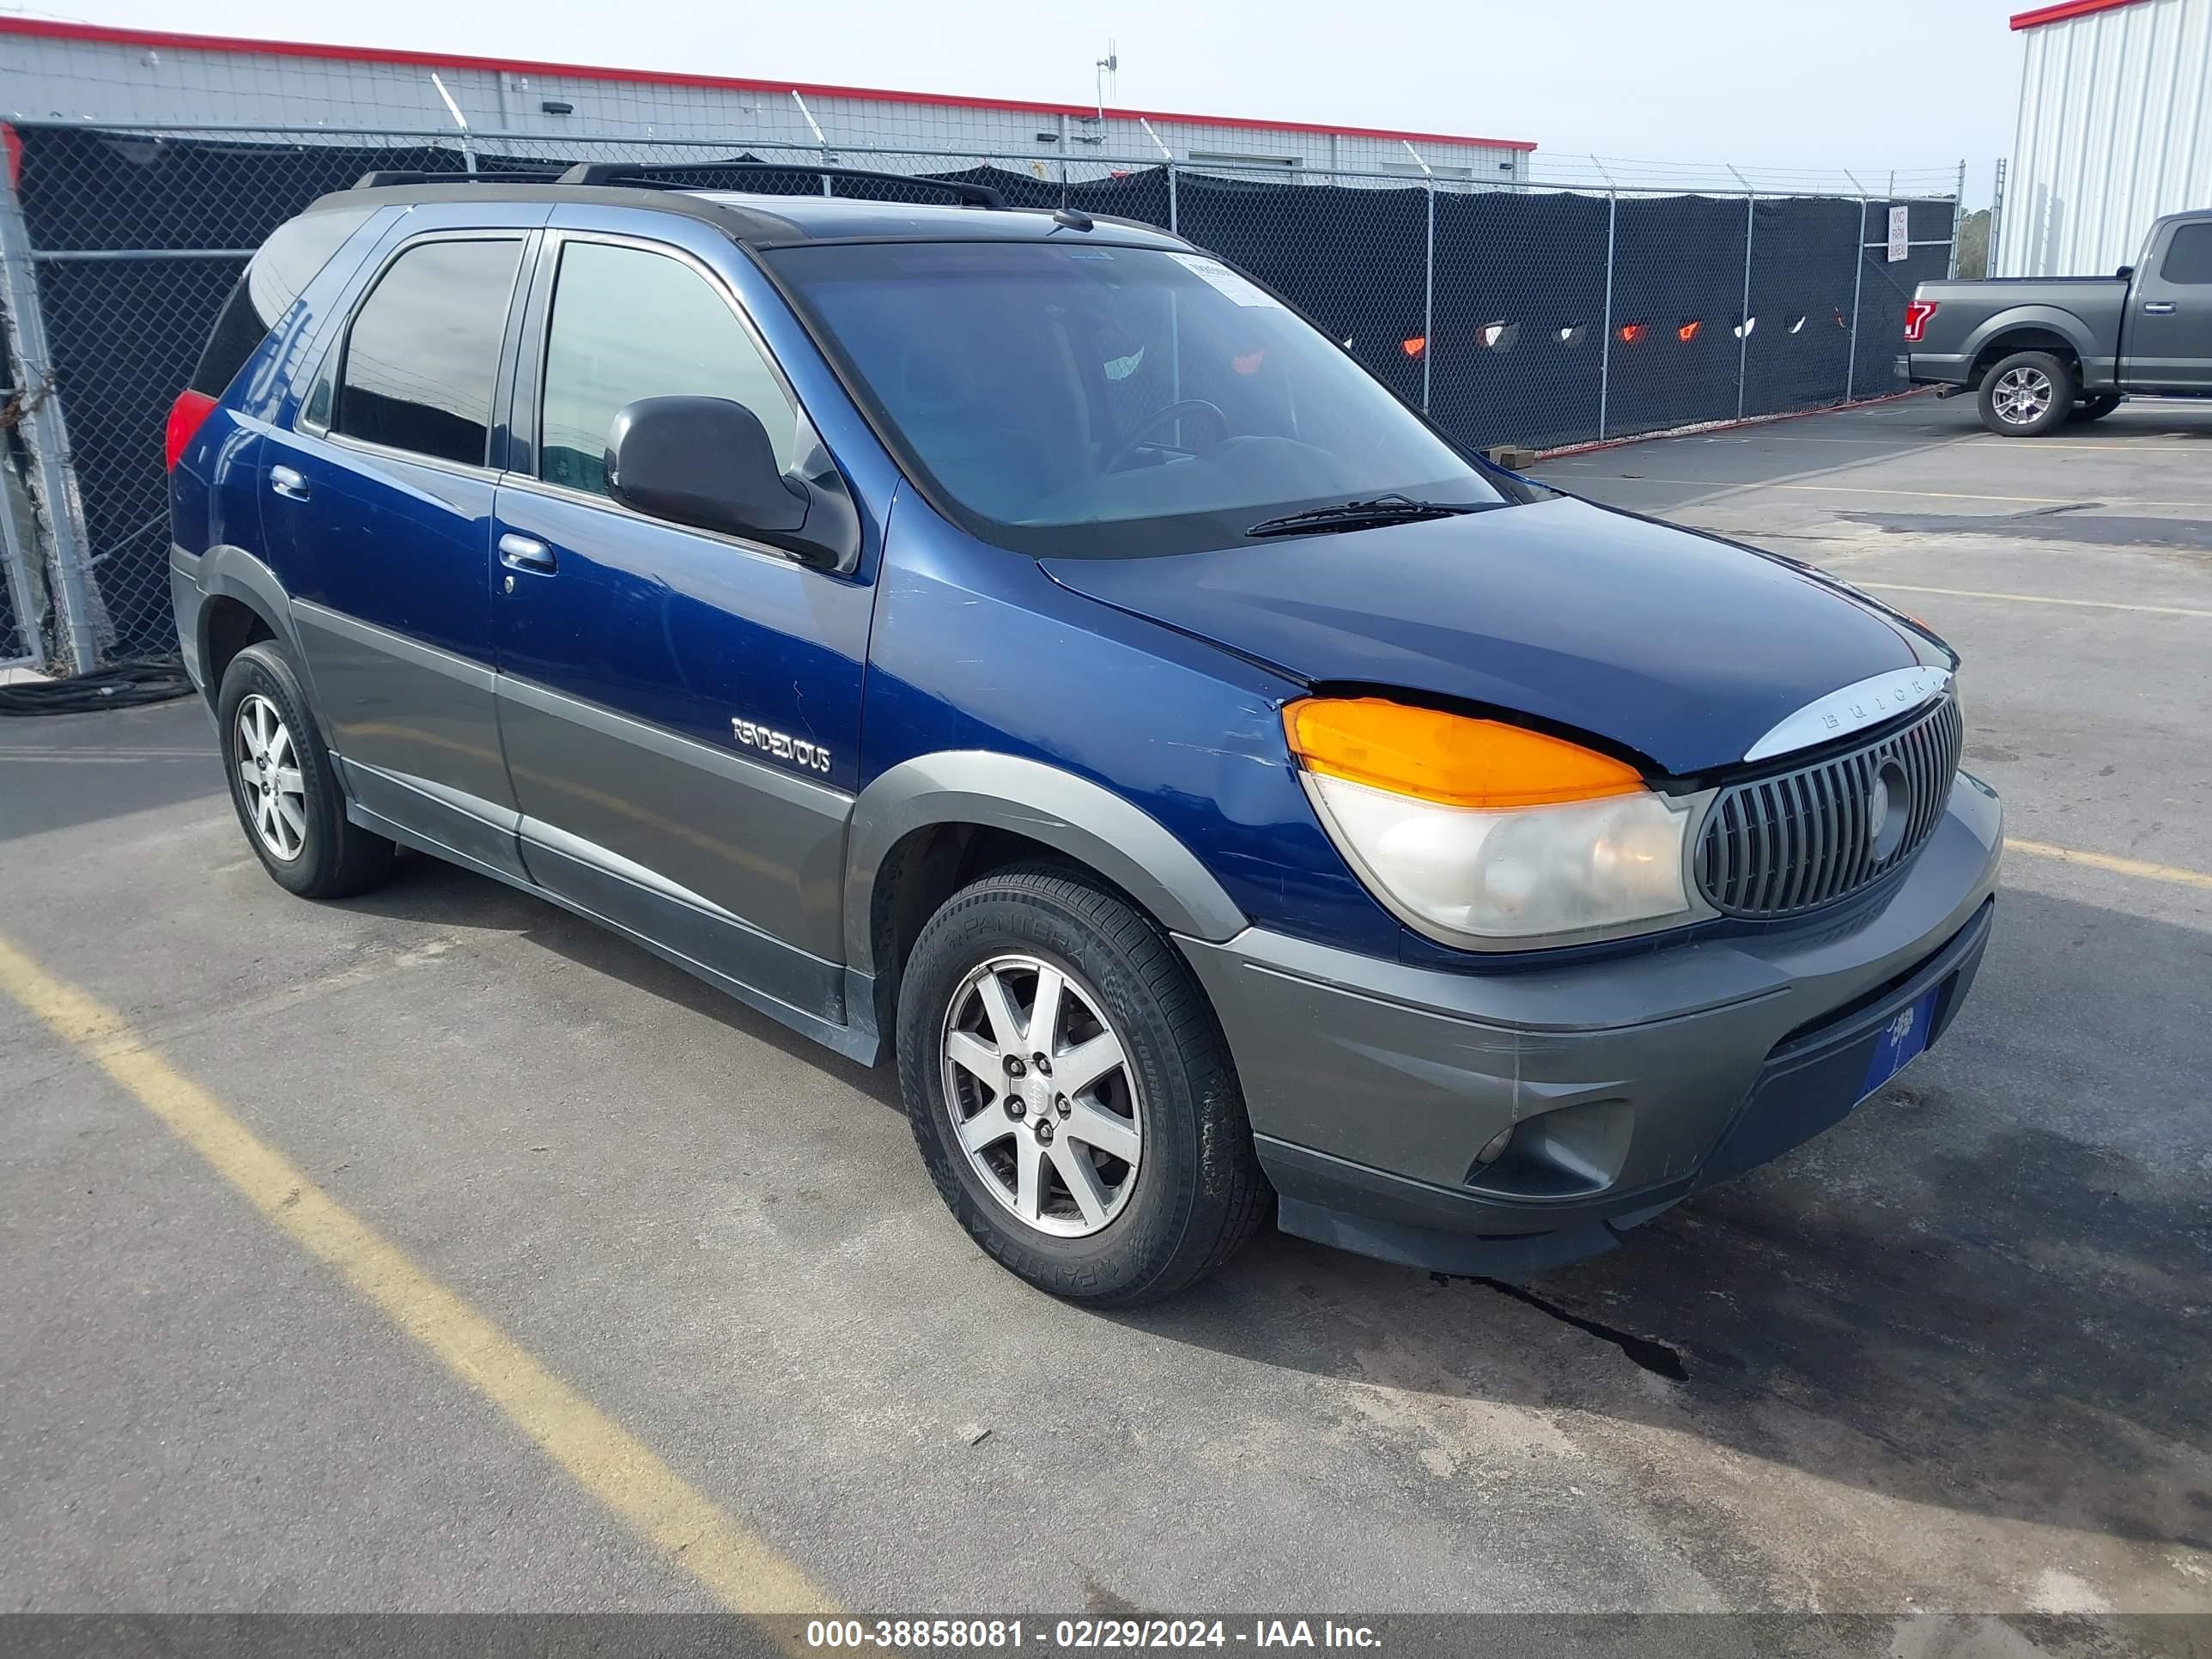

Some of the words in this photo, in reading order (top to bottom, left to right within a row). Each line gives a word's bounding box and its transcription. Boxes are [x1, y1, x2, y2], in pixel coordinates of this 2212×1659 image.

[1893, 211, 1905, 223] VIC
[1820, 679, 1925, 730] BUICK
[732, 717, 831, 773] RENDEZVOUS
